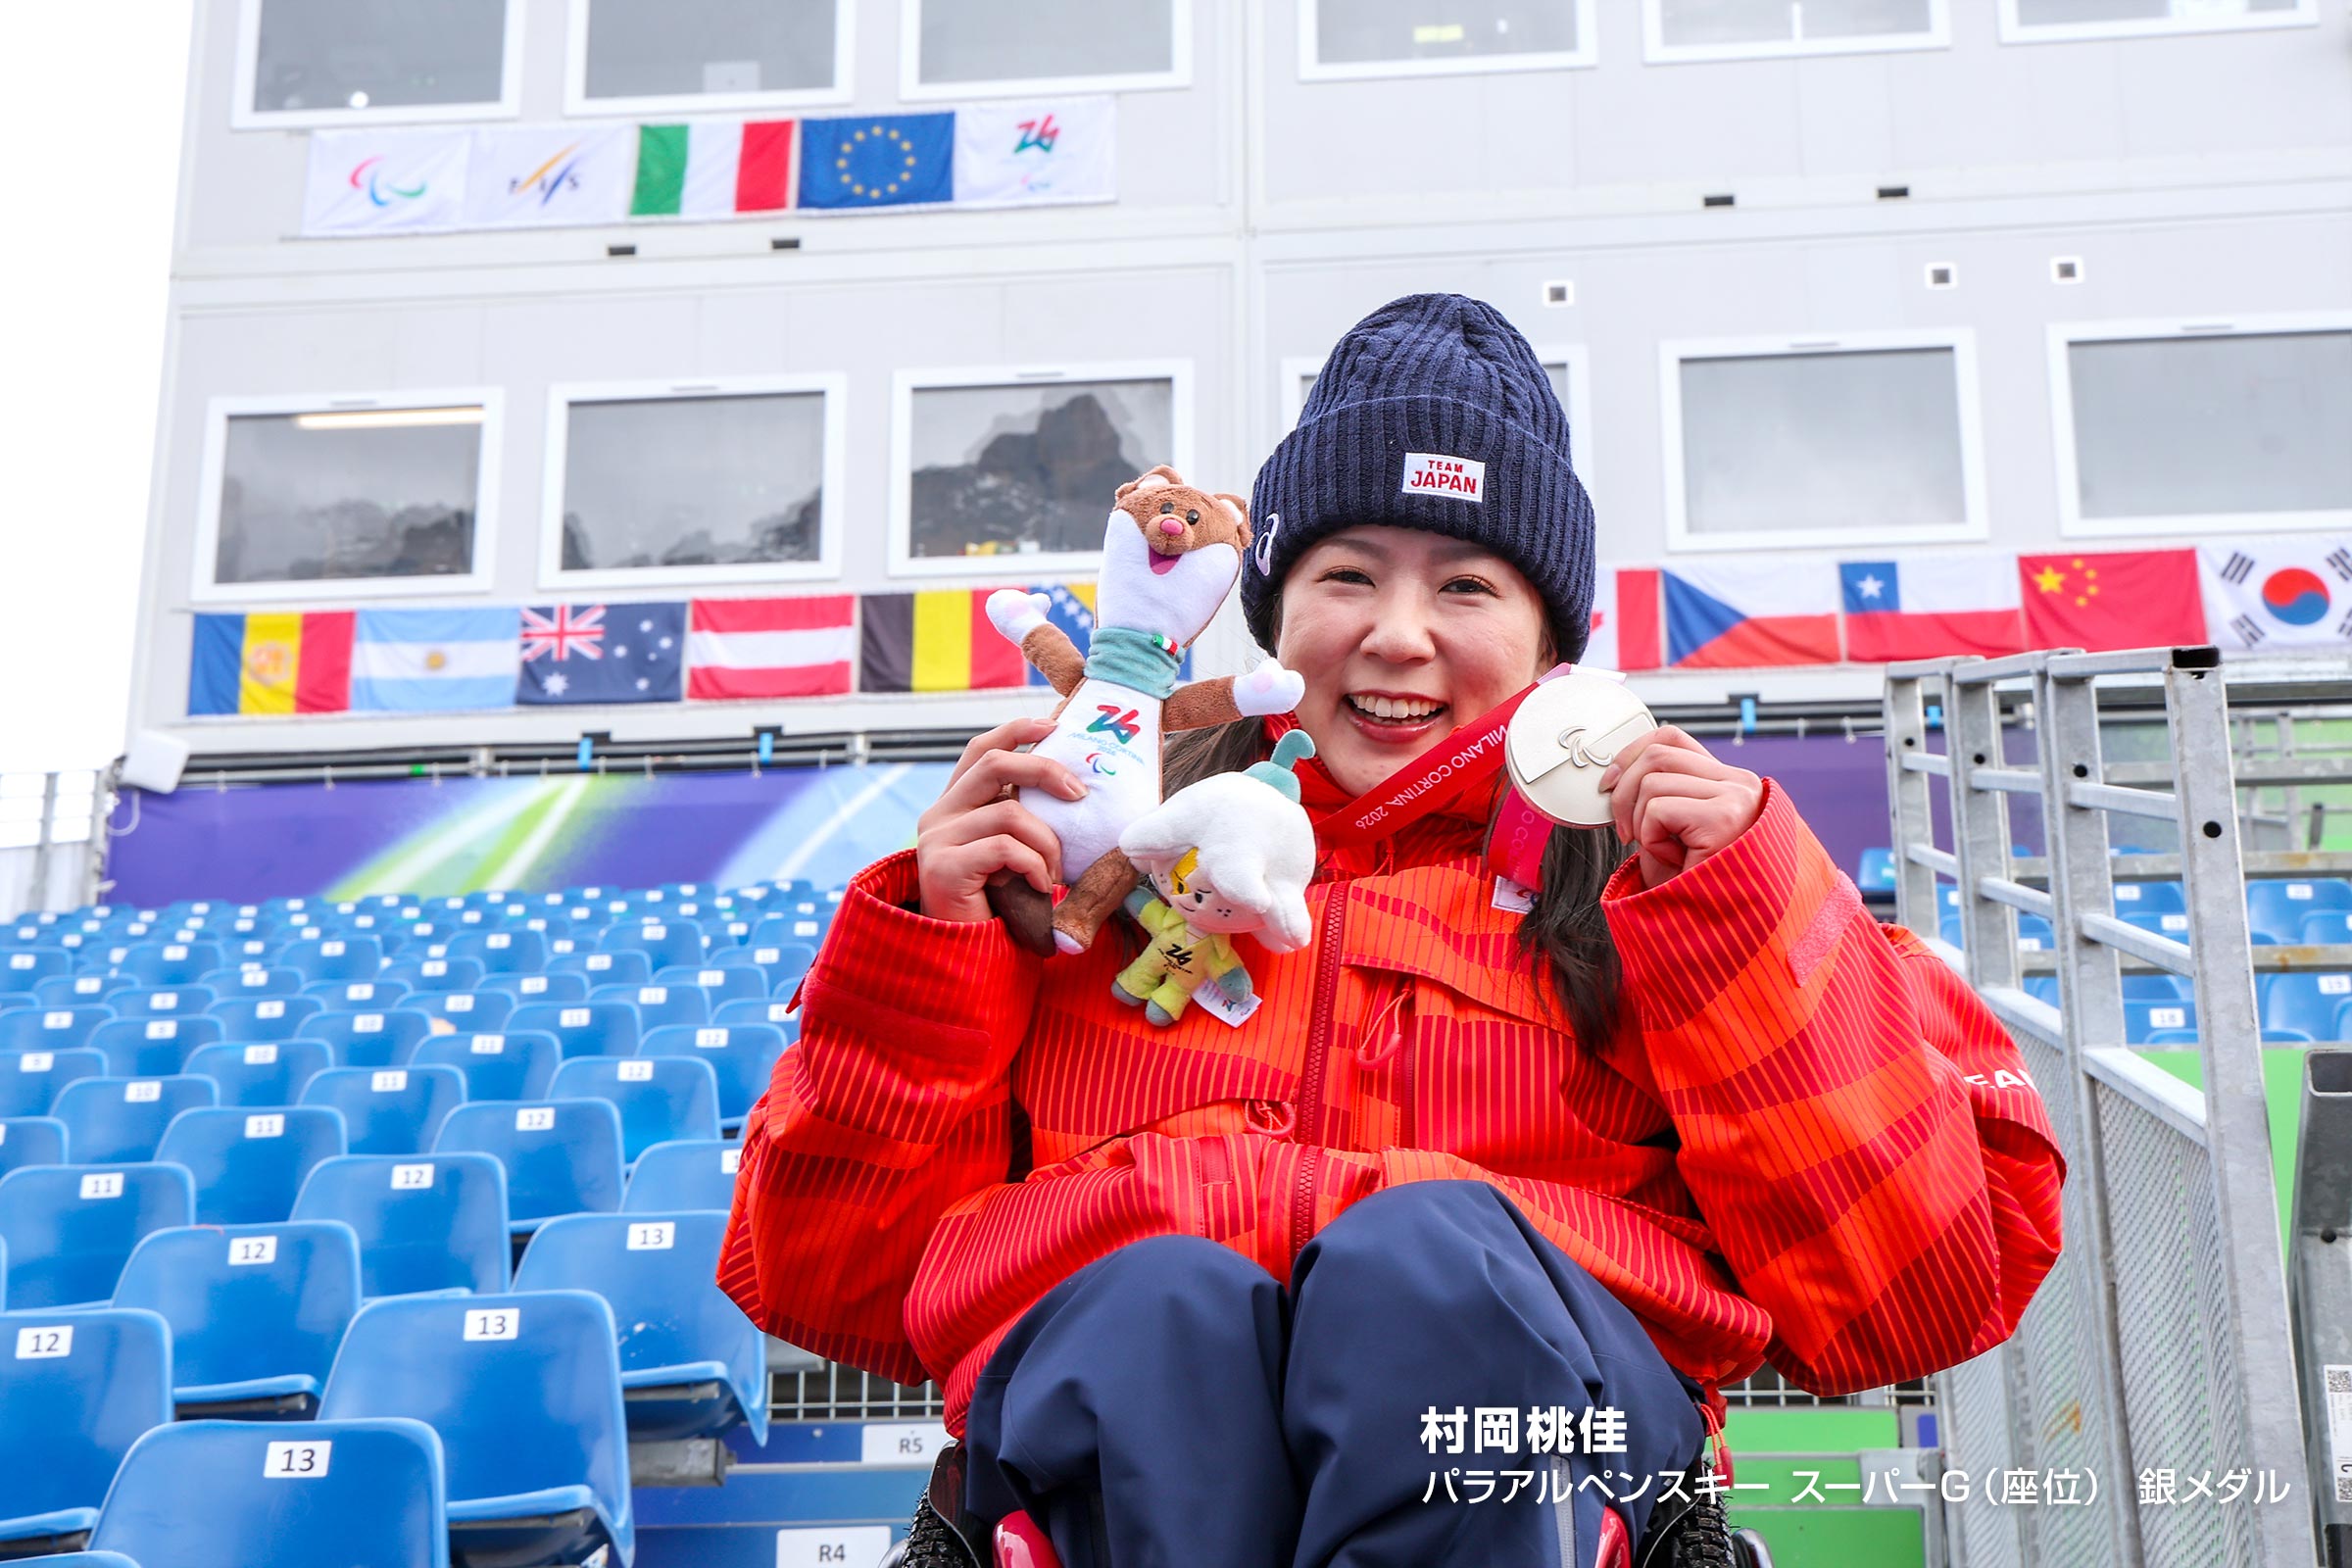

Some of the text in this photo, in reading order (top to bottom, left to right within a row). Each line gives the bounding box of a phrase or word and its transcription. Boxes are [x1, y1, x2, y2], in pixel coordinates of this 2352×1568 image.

[1428, 460, 1463, 473] TEAM
[1410, 470, 1477, 494] JAPAN
[1385, 764, 1452, 807] CORTINA
[1355, 806, 1389, 830] 2026
[628, 1065, 645, 1079] 12
[1963, 1068, 2038, 1094] EA
[382, 1075, 400, 1089] 11
[135, 1085, 154, 1099] 10
[256, 1119, 274, 1133] 11
[527, 1112, 546, 1126] 12
[92, 1178, 113, 1194] 11
[403, 1169, 424, 1185] 12
[640, 1228, 664, 1246] 13
[242, 1242, 266, 1260] 12
[478, 1315, 507, 1336] 13
[30, 1332, 60, 1353] 12
[899, 1437, 923, 1454] R5
[280, 1448, 316, 1472] 13
[818, 1544, 846, 1563] R4
